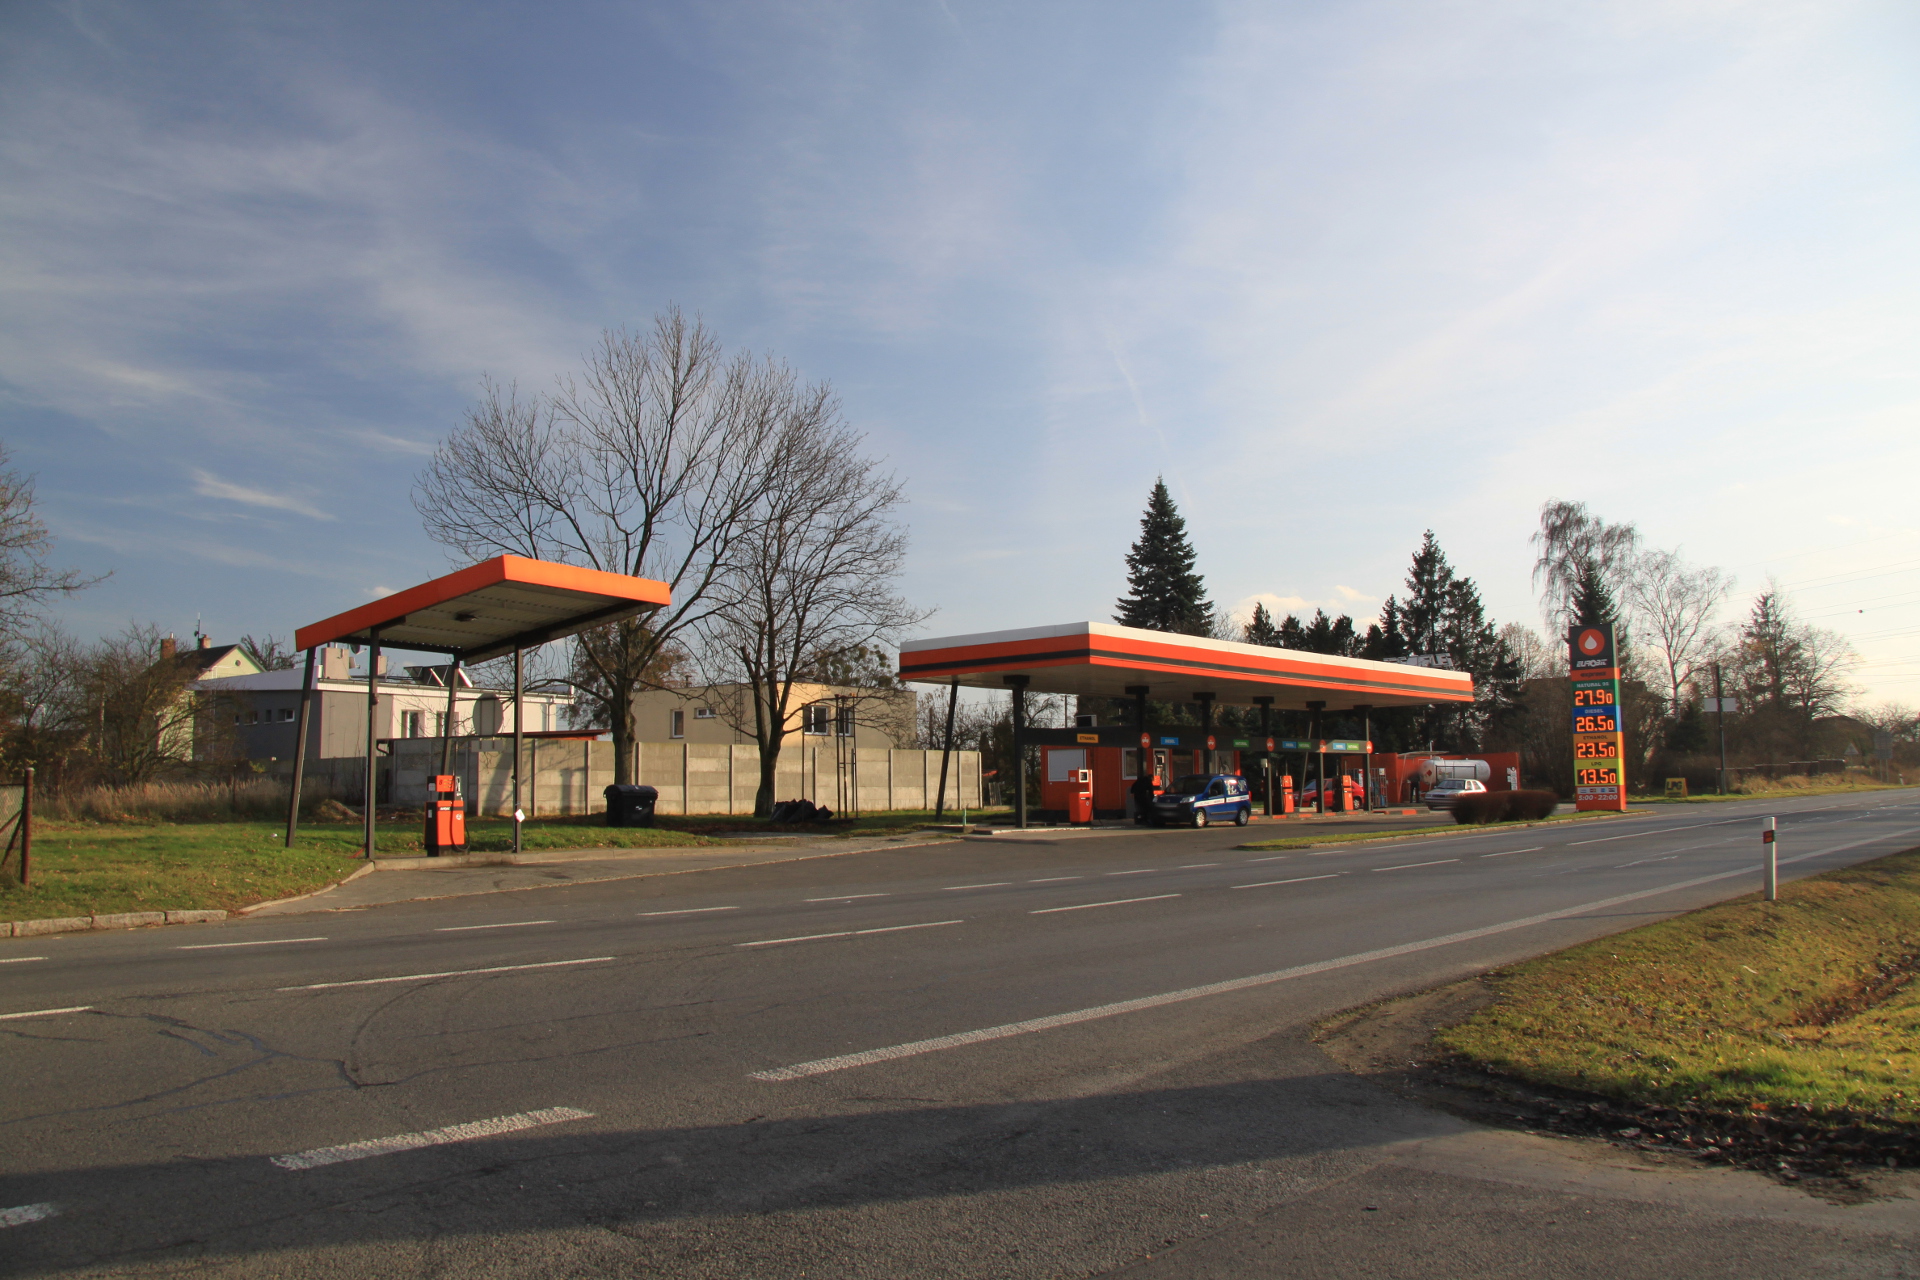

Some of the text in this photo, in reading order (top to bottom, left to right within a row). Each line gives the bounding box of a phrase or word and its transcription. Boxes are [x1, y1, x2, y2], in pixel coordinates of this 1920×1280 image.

[1575, 689, 1613, 706] 27.90
[1576, 715, 1614, 732] 26.50
[1577, 742, 1615, 758] 23.50
[1580, 768, 1616, 784] 13.50
[1666, 781, 1683, 791] LPG
